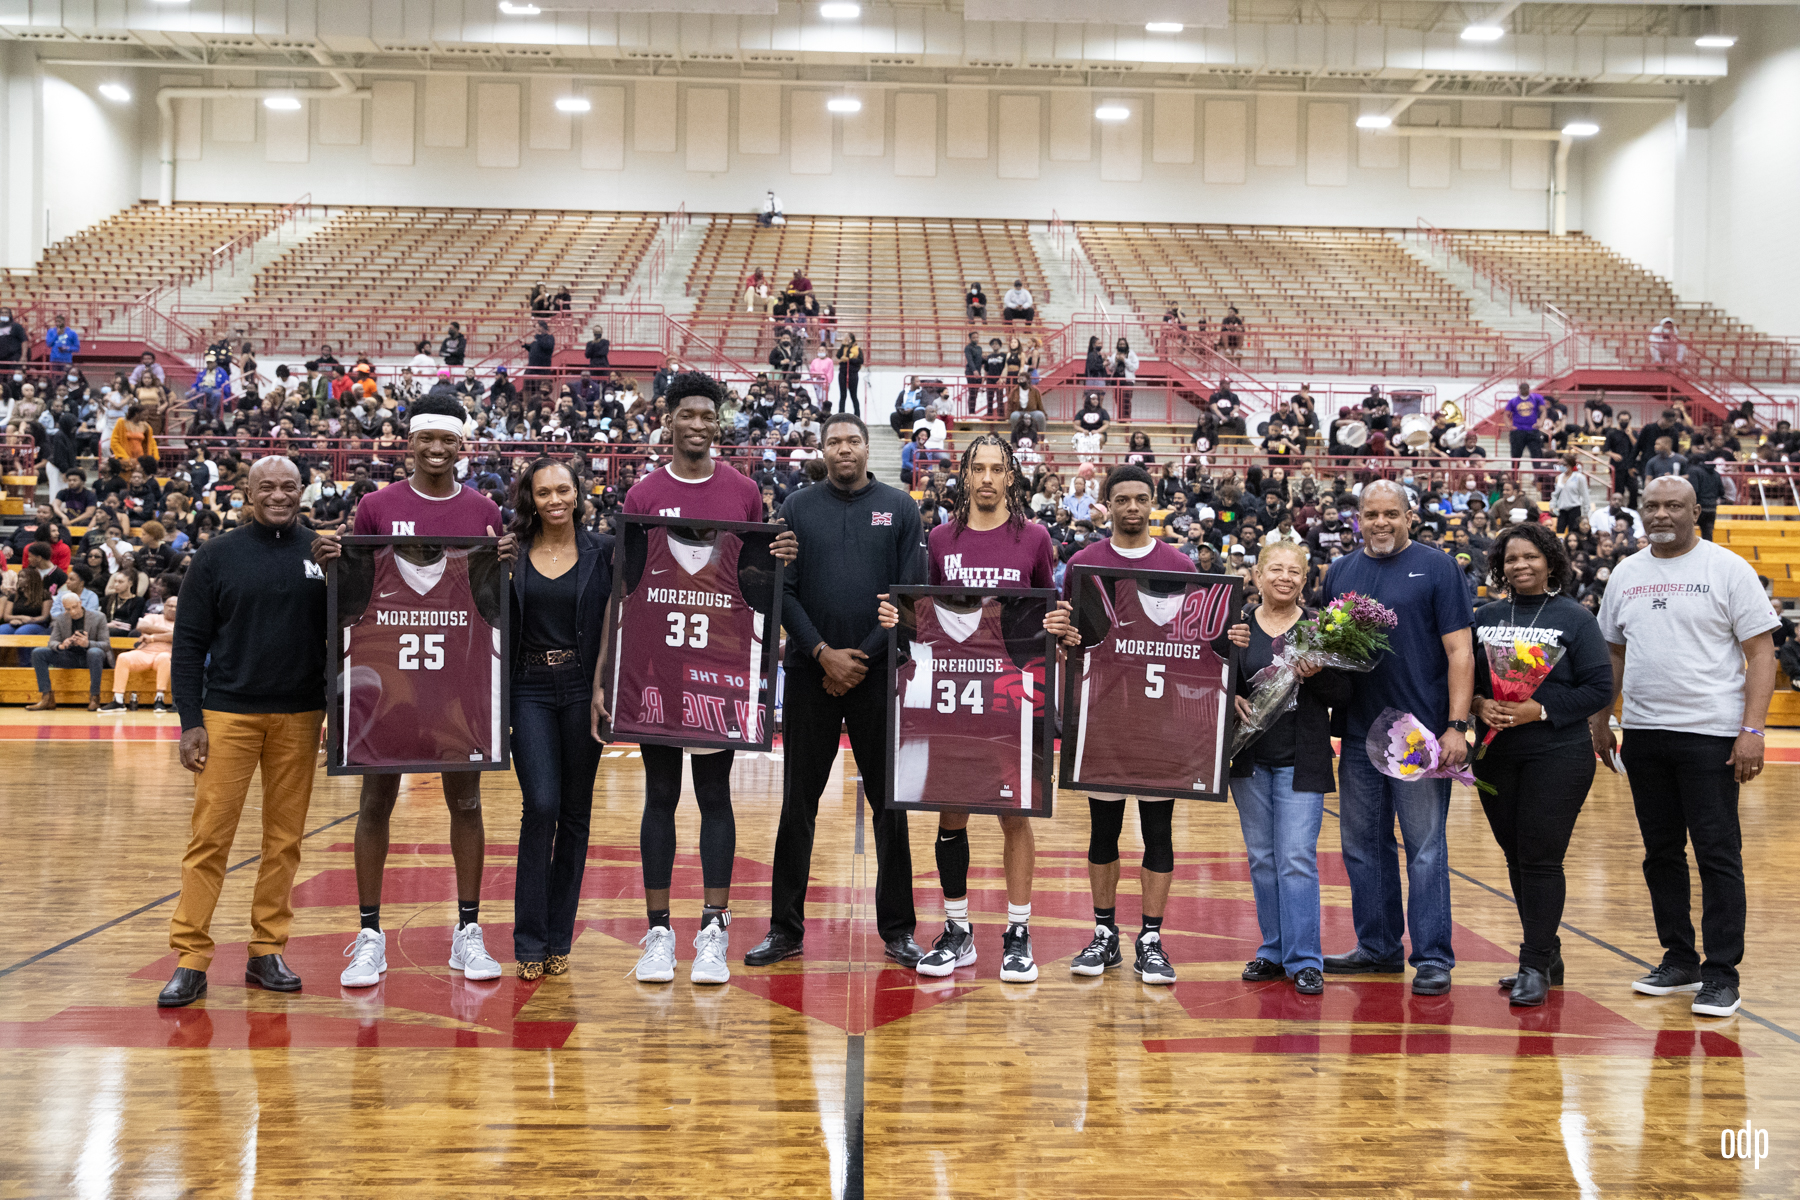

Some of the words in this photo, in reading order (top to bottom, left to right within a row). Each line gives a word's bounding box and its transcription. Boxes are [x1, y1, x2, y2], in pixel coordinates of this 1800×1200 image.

[660, 508, 680, 517] IN
[392, 521, 415, 536] IN
[944, 553, 962, 570] IN
[945, 567, 1021, 582] WHITTLER
[647, 587, 732, 608] MOREHOUSE
[376, 610, 468, 626] MOREHOUSE
[665, 612, 709, 649] 33
[1476, 625, 1563, 648] MOREHOUSE
[398, 633, 445, 670] 25
[1115, 638, 1201, 660] MOREHOUSE
[918, 658, 1004, 673] MOREHOUSE
[1144, 663, 1166, 699] 5
[936, 679, 984, 714] 34
